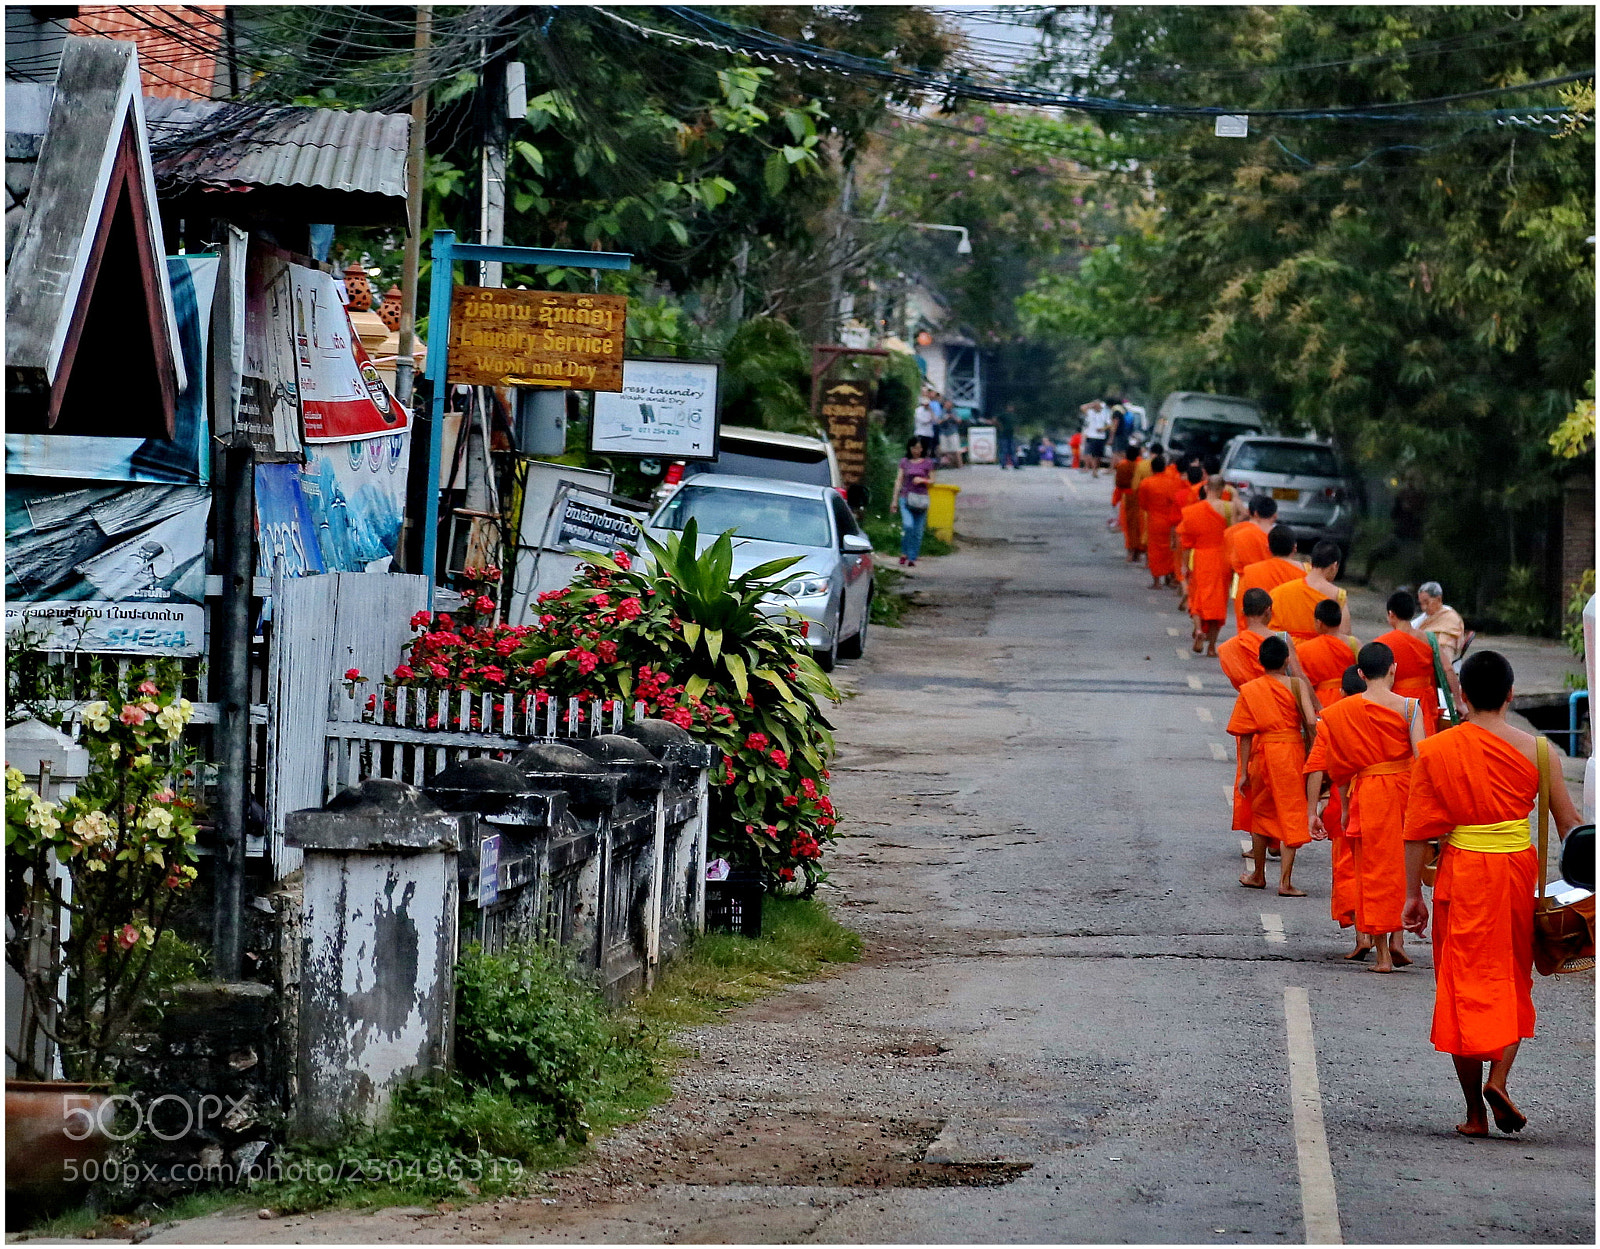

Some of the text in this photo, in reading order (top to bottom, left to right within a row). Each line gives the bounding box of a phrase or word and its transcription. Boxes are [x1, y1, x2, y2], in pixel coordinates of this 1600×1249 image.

[461, 323, 613, 357] Laundry Service
[476, 355, 597, 384] Wash and Dry
[623, 385, 704, 400] ress Laundry
